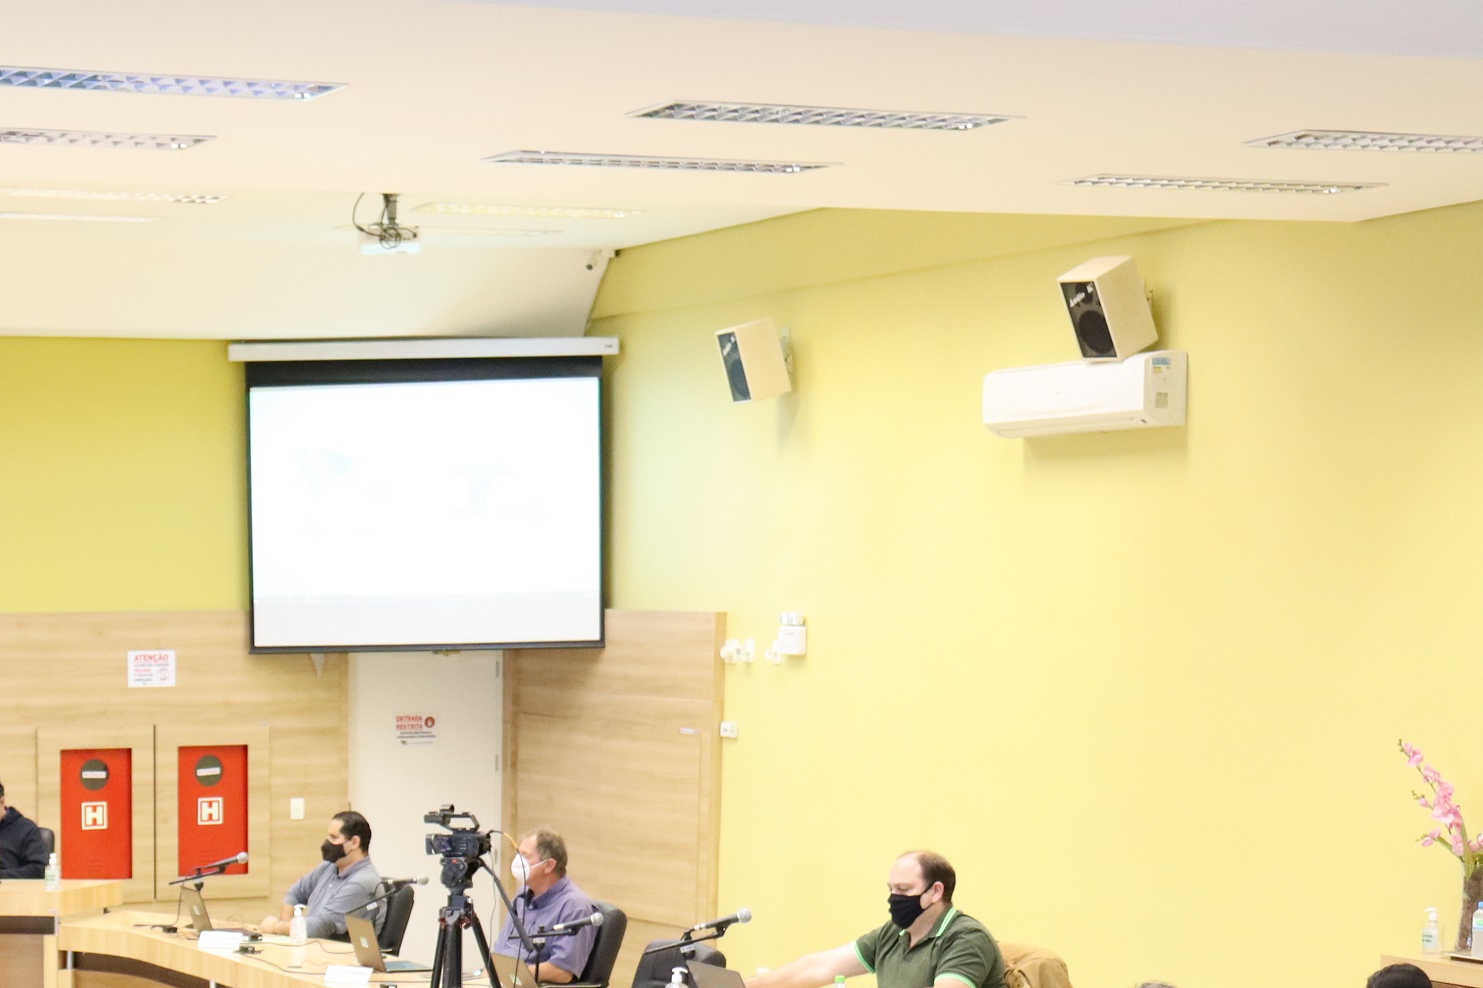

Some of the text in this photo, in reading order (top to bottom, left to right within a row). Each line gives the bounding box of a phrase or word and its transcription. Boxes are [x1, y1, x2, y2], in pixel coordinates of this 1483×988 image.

[134, 652, 168, 662] ATENÇÃO
[85, 806, 103, 826] H
[202, 801, 219, 821] H
